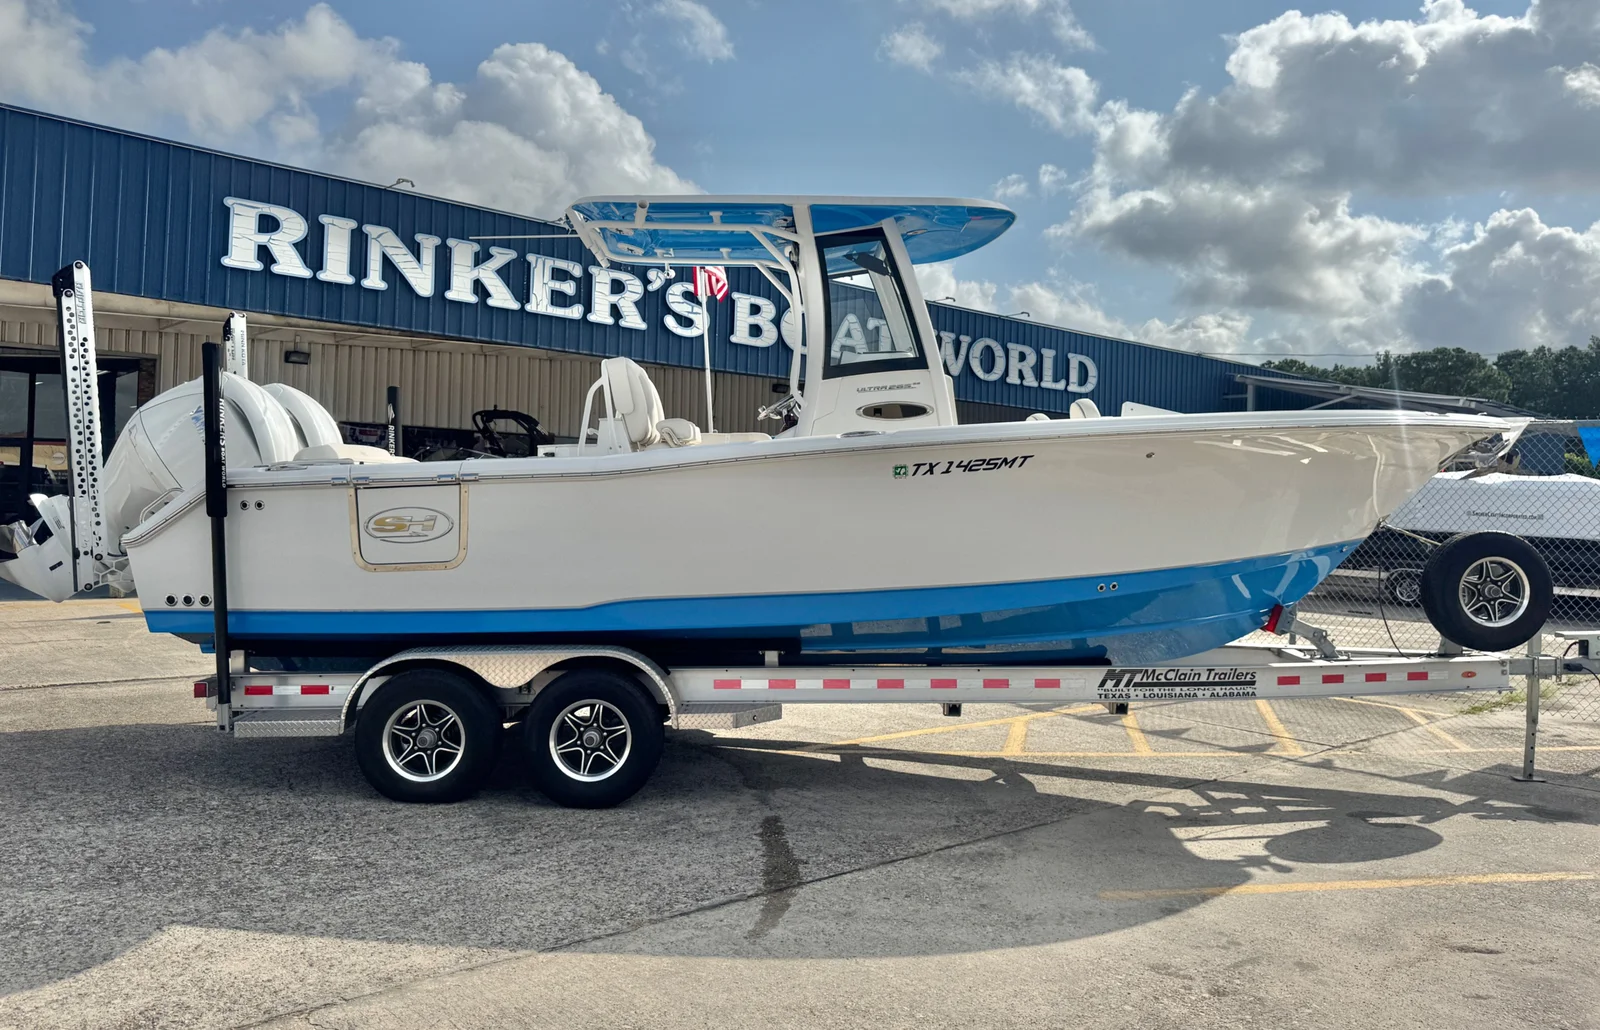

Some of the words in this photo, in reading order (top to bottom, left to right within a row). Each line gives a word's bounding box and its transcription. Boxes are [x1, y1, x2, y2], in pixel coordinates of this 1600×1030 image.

[220, 196, 710, 338] RINKER'S
[911, 462, 941, 476] TX
[940, 455, 1035, 475] 1425MT
[371, 515, 438, 533] SH
[1140, 669, 1202, 682] McClain
[1206, 667, 1257, 681] Trailers
